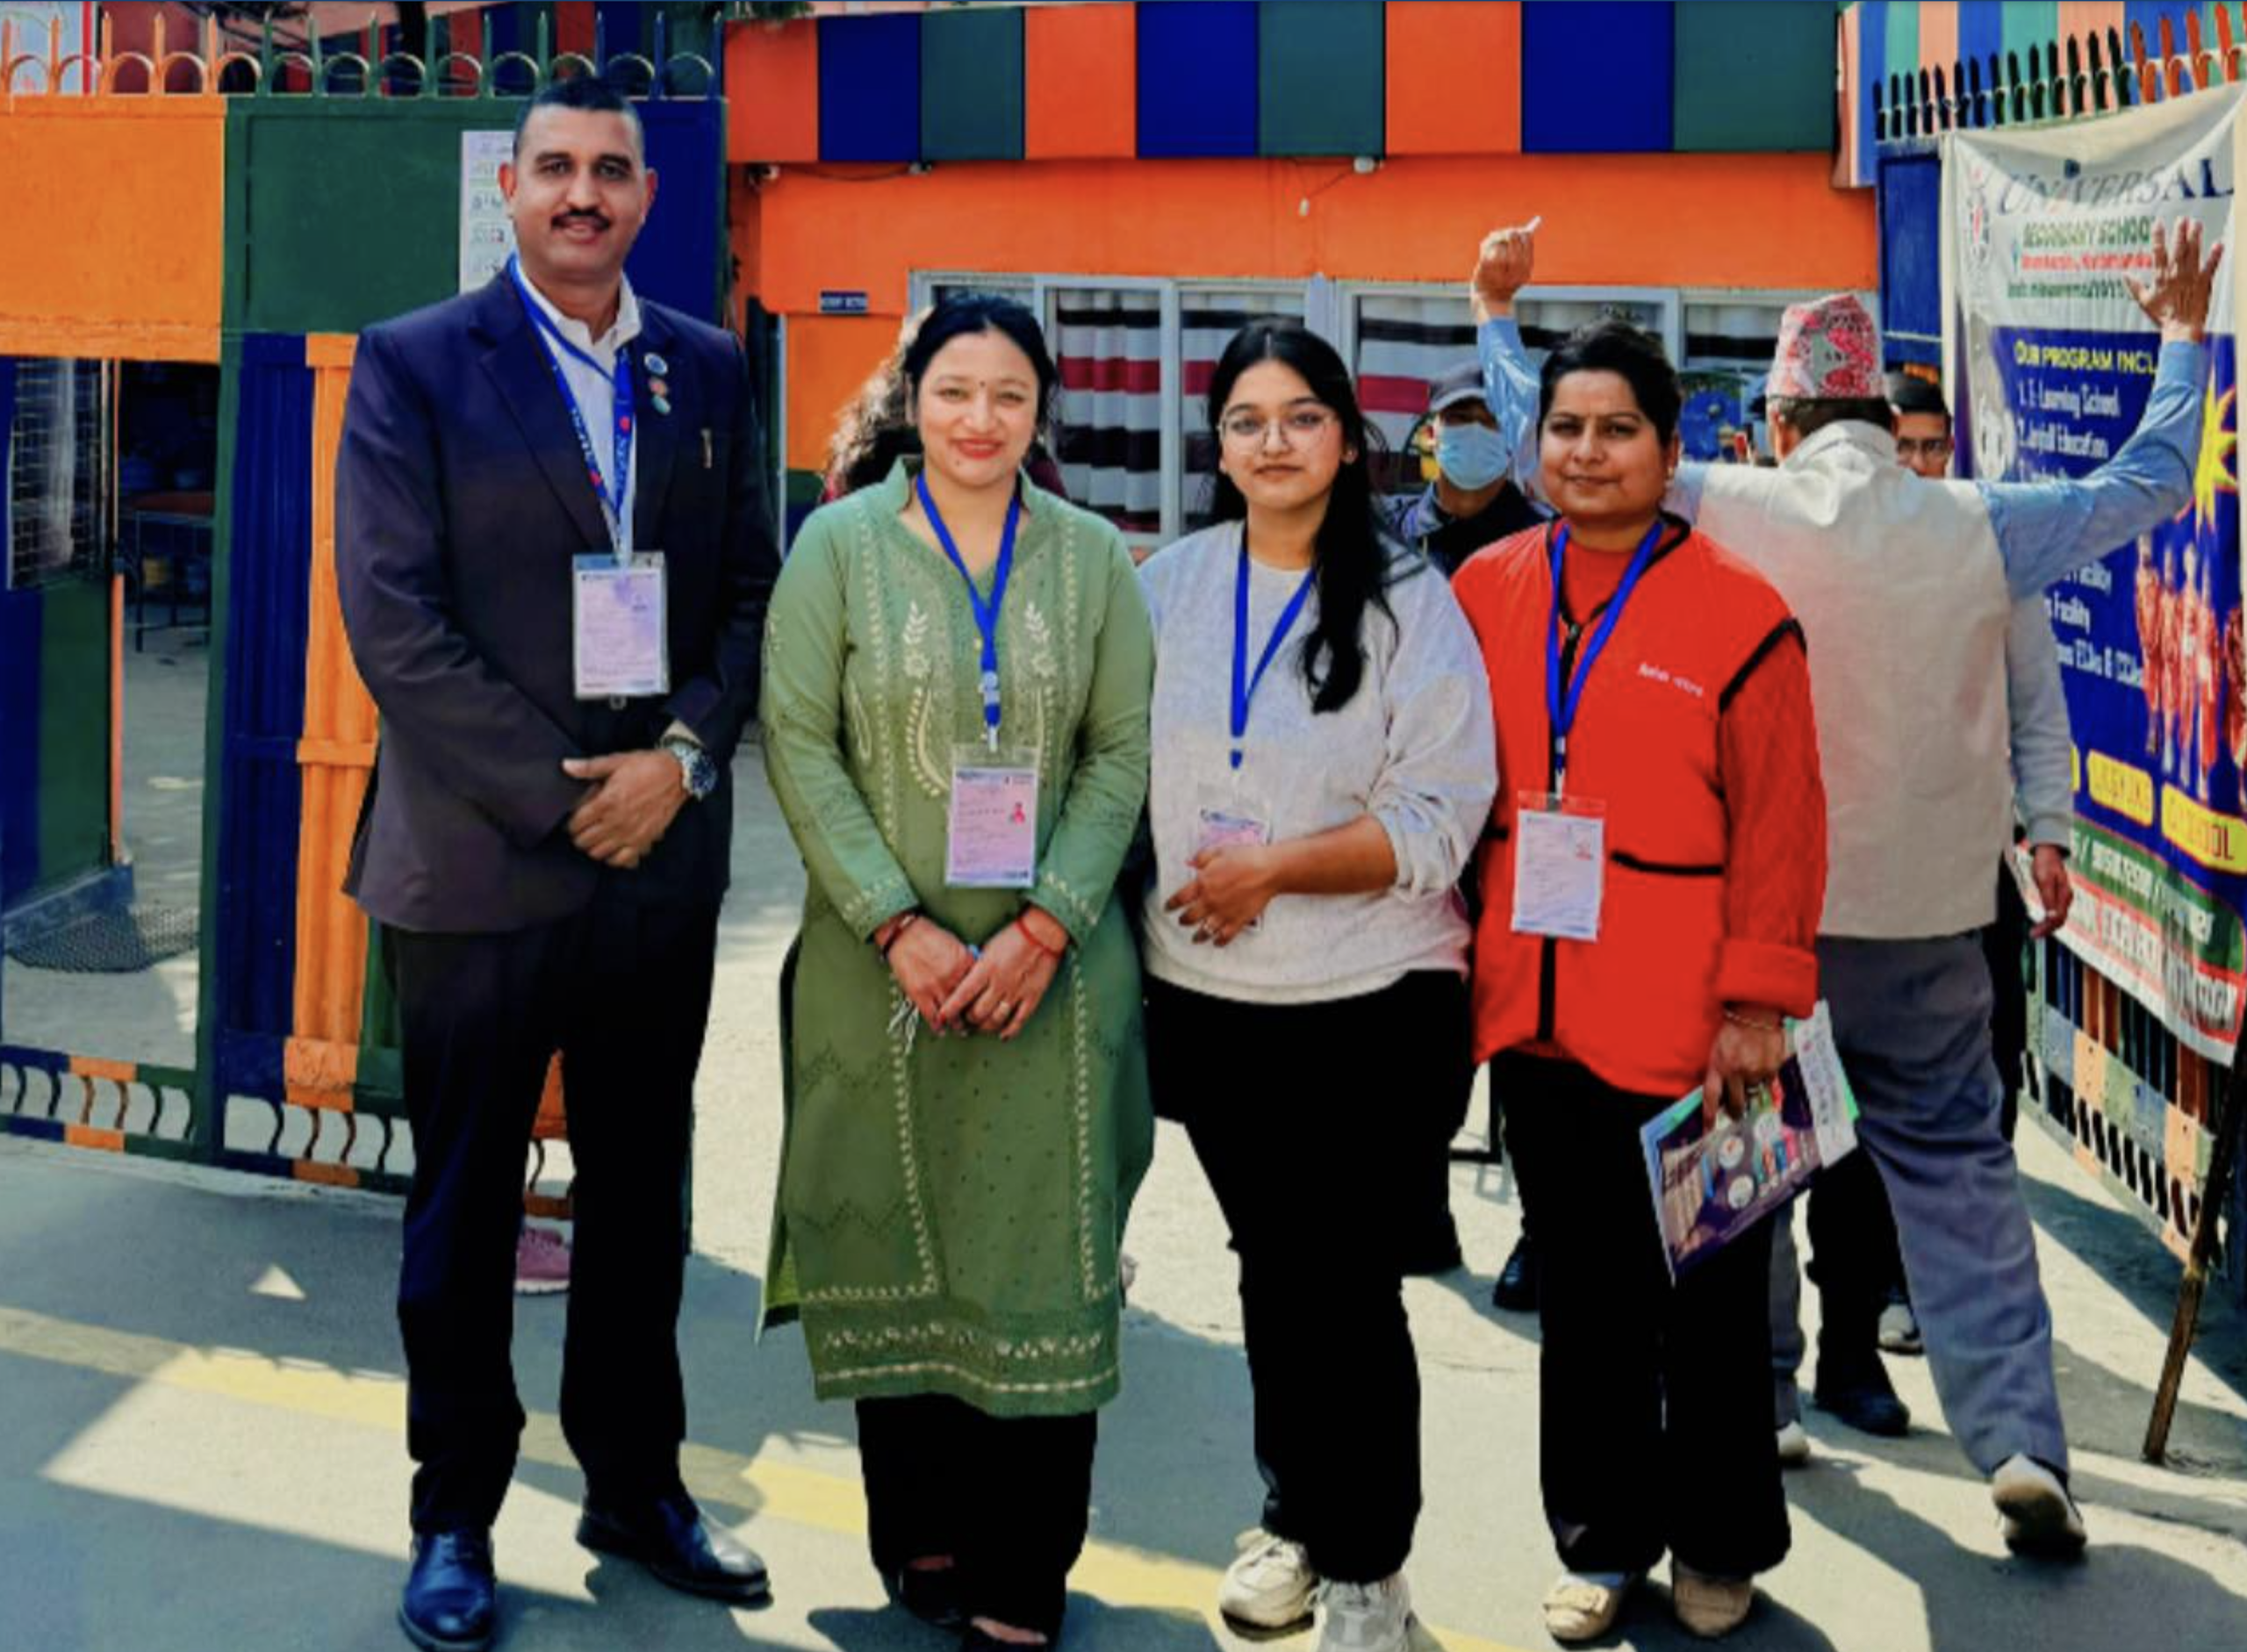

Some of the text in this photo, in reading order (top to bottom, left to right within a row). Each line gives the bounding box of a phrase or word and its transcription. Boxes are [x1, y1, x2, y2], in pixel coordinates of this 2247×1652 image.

[2099, 215, 2156, 244] SCHOO
[2043, 346, 2113, 370] PROGRAM
[2118, 350, 2158, 374] INCL
